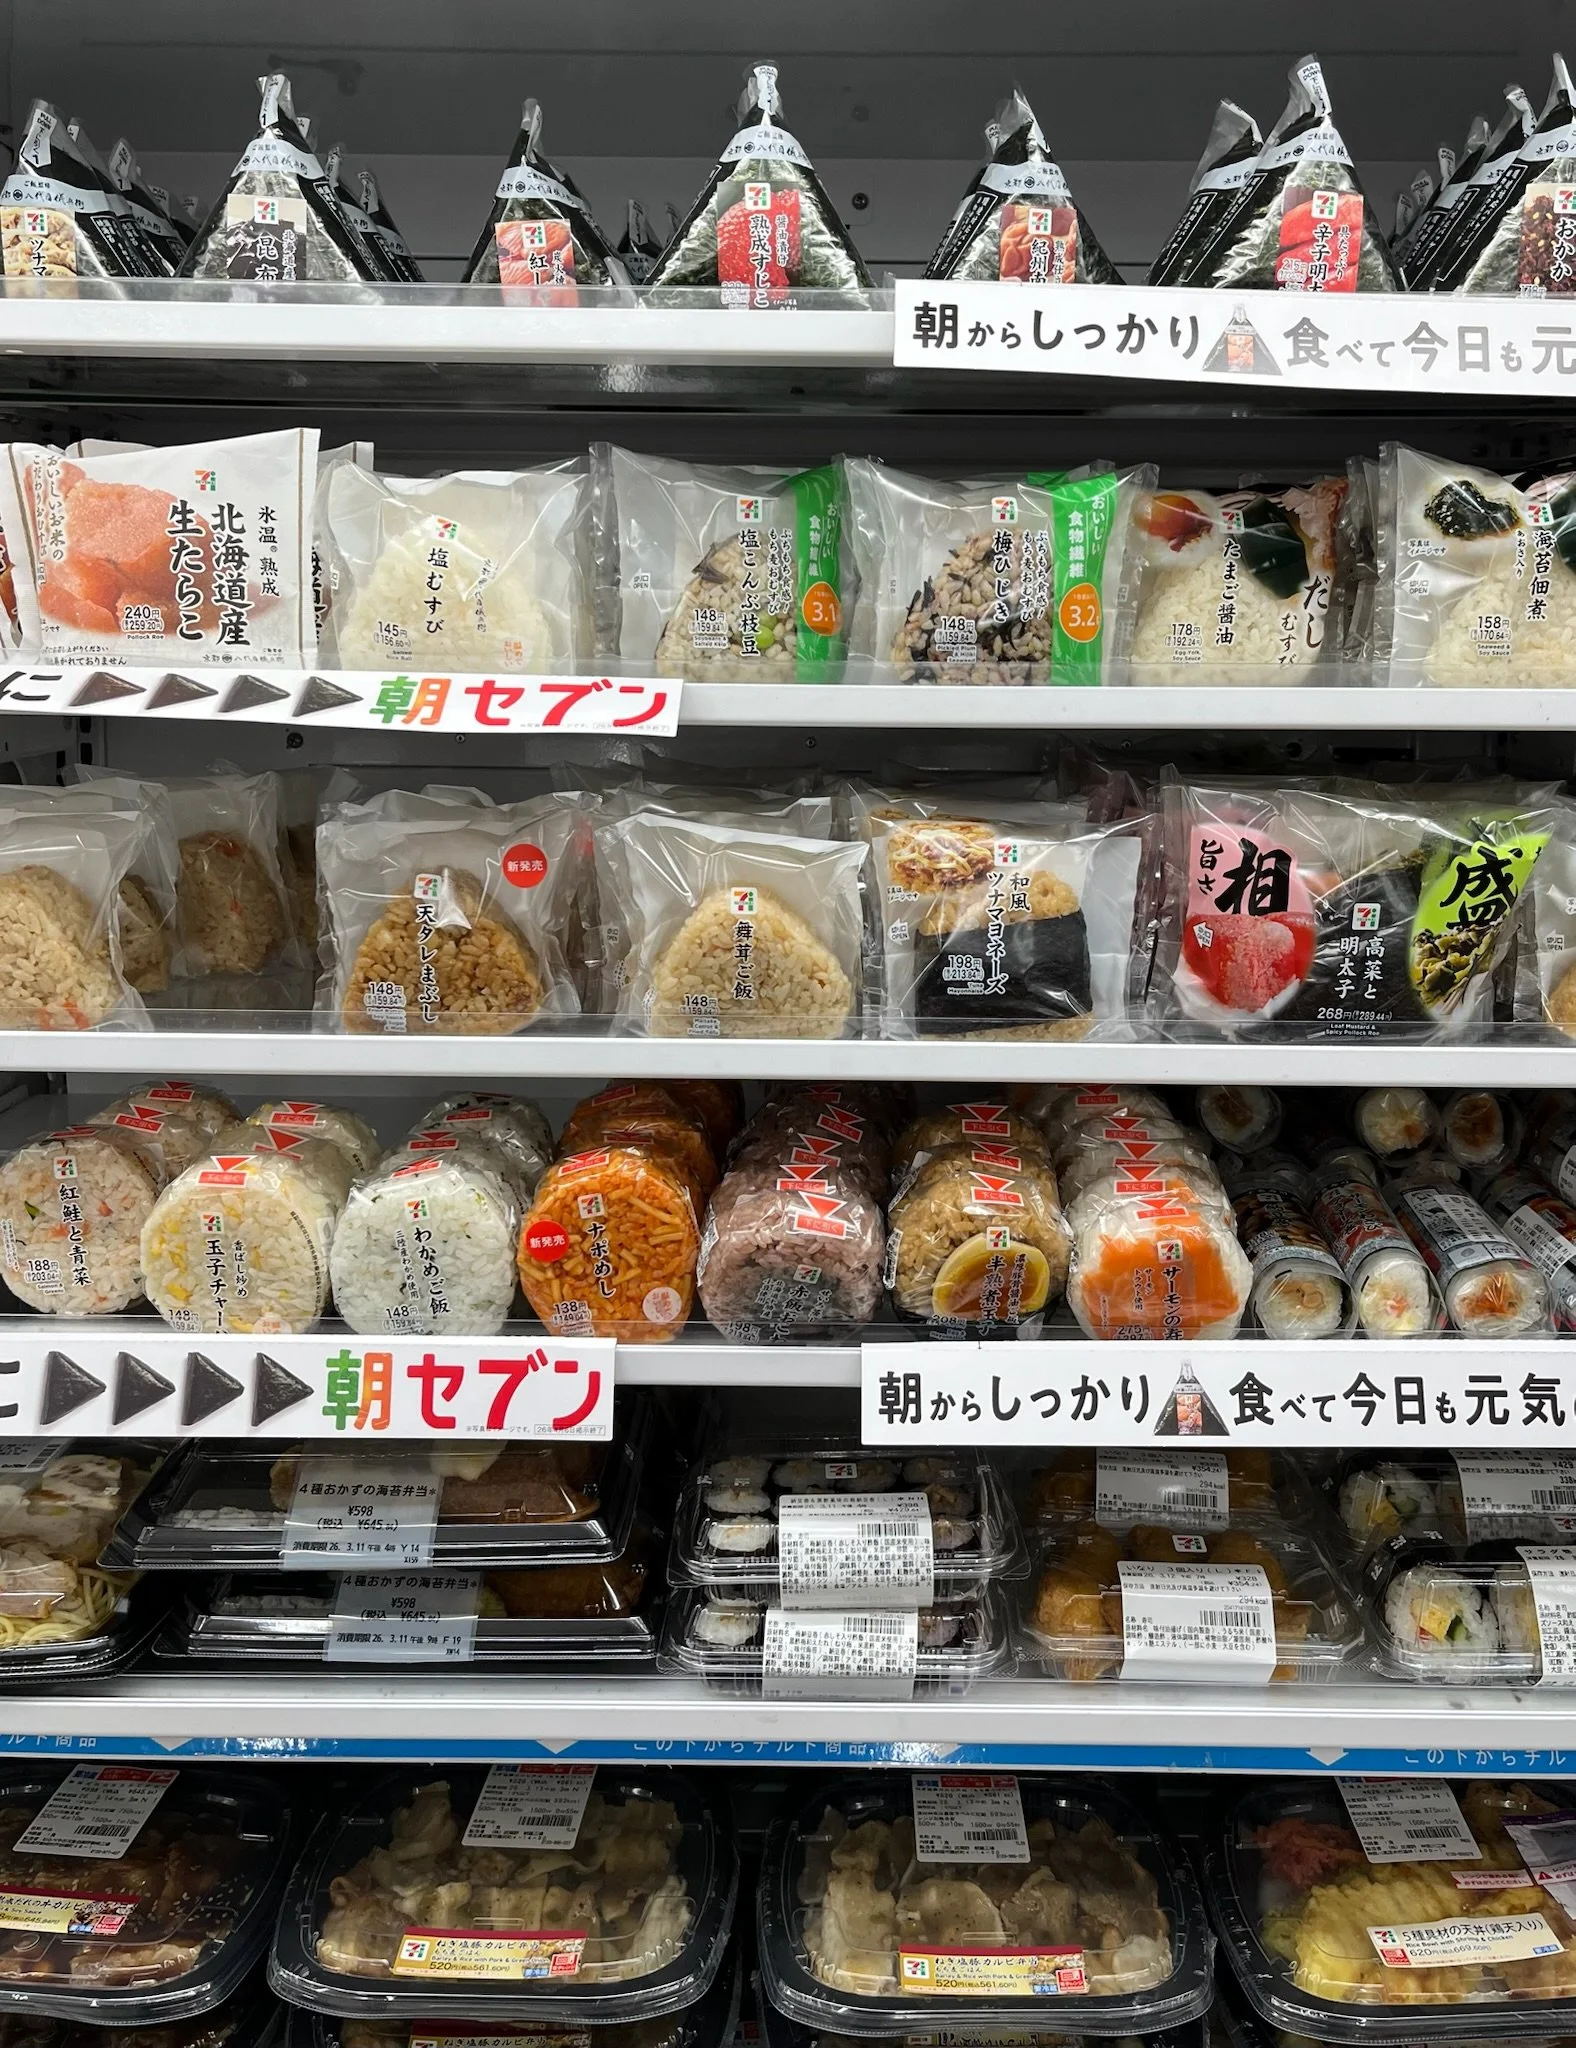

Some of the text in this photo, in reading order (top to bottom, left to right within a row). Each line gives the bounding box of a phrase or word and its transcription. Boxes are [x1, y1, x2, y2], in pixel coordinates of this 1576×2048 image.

[255, 235, 279, 281] 昆布
[750, 215, 772, 309] 熟成すじこ
[775, 215, 790, 267] 醤油漬け
[1334, 225, 1351, 280] 具たっぷり
[1551, 218, 1576, 282] おかか
[913, 301, 1200, 359] 朝からしっかり
[47, 454, 64, 561] おいしいお米の
[166, 500, 205, 642] 生たらこ
[767, 528, 781, 614] もち麦おむすび
[1068, 510, 1085, 578] 食物繊維
[1407, 547, 1447, 555] イメージです
[1409, 539, 1430, 548] 写真は
[210, 503, 253, 646] 北海道産
[424, 548, 450, 634] 塩むすび
[632, 582, 650, 590] OPEN
[739, 528, 761, 657] 塩こんぶ枝豆
[993, 528, 1014, 622] 梅ひじき
[1021, 531, 1034, 621] もち麦おむすび
[1215, 538, 1242, 645] たまご醤油
[1409, 587, 1428, 595] OPEN
[1527, 530, 1556, 620] 海苔佃煮
[124, 606, 160, 619] 240円
[377, 621, 408, 638] 145円
[694, 609, 726, 622] 148円
[942, 617, 974, 631] 148円
[1171, 623, 1201, 635] 178円
[1303, 575, 1331, 649] だし
[1477, 616, 1510, 629] 158円
[1278, 613, 1299, 670] むすび
[369, 675, 668, 727] 朝セブン
[506, 860, 544, 872] 新発売
[1009, 871, 1031, 912] 和風
[1215, 837, 1292, 915] 相
[1439, 846, 1522, 931] 盛
[733, 919, 755, 999] 舞茸ご飯
[984, 871, 1009, 995] ツナマヨネーズ
[368, 982, 403, 995] 148円
[416, 904, 441, 1023] 天タレまぶし
[948, 955, 982, 969] 198円
[1334, 935, 1359, 1000] 明太子
[1364, 935, 1387, 1000] 高菜と
[684, 995, 717, 1007] 148円
[1124, 1182, 1158, 1192] 下に引く
[59, 1183, 92, 1287] 紅鮭と青菜
[529, 1235, 566, 1249] 新発売
[587, 1222, 616, 1299] ナポめし
[27, 1259, 59, 1272] 188円
[204, 1239, 230, 1335] 玉子チャー
[233, 1240, 248, 1298] 香ばし炒め
[413, 1227, 450, 1315] わかめご飯
[385, 1305, 419, 1319] 148円
[554, 1301, 586, 1315] 138円
[976, 1254, 1006, 1336] 半熟煮玉子
[1162, 1266, 1184, 1340] サーモンの寿
[322, 1348, 601, 1430] 朝セブン
[878, 1370, 1576, 1427] 朝からしっかり 食べて今日も元気
[347, 1505, 374, 1516] ¥598
[410, 1543, 420, 1552] 14
[390, 1597, 416, 1608] ¥598
[436, 1939, 541, 1951] ねぎ塩豚カルビ弁当
[1402, 1919, 1545, 1942] 5種具材の天丼(鶏天入り)
[1422, 1940, 1439, 1948] Bowl
[934, 1957, 1039, 1967] ねぎ塩豚カルビ弁当
